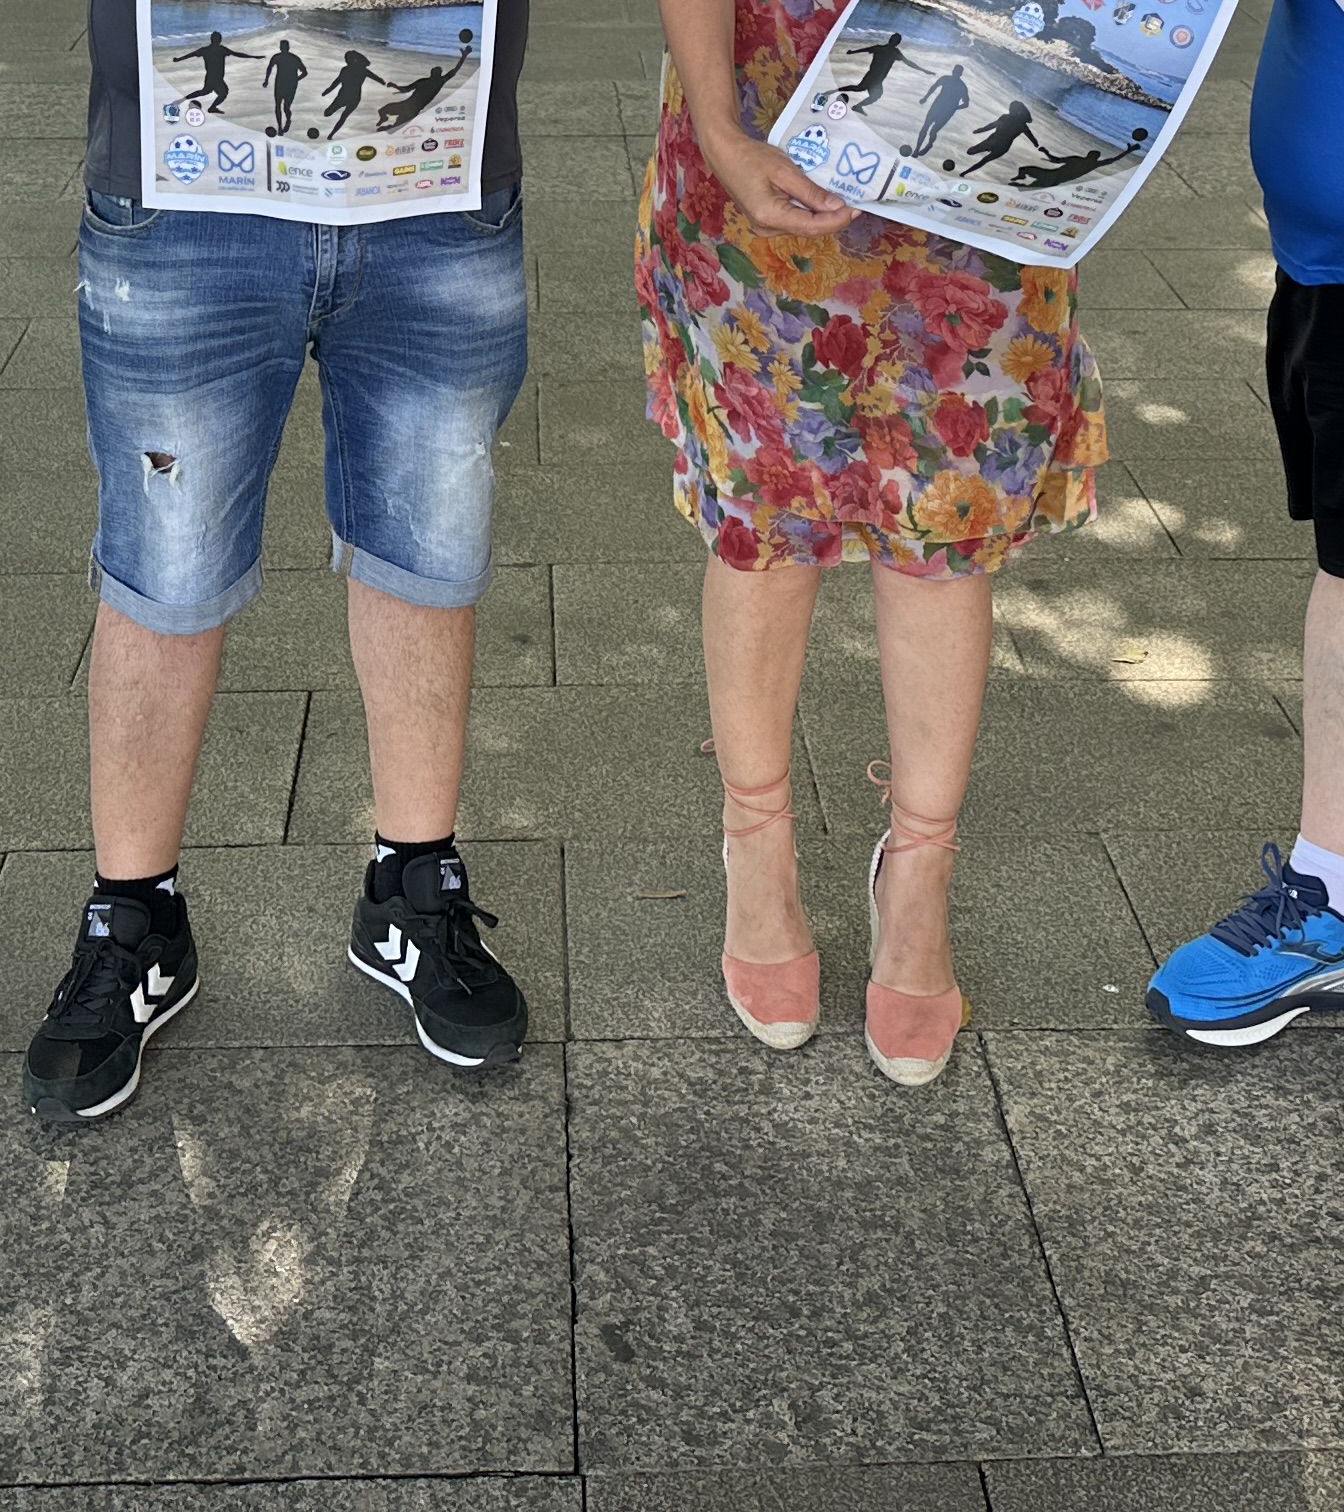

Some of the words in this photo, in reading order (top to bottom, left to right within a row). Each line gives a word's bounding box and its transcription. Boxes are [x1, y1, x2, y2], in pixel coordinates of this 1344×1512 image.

[288, 166, 313, 178] ence
[218, 175, 255, 186] MARÍN
[828, 178, 865, 198] MARÍN
[904, 190, 930, 201] ence
